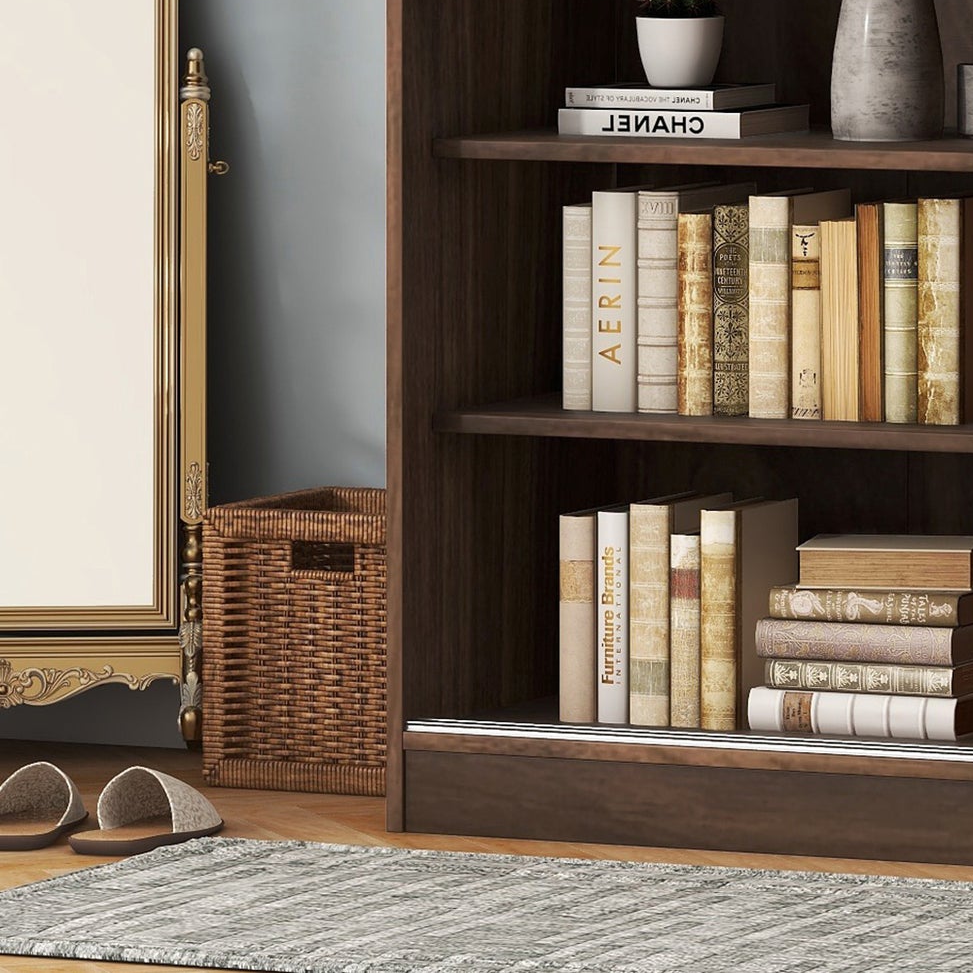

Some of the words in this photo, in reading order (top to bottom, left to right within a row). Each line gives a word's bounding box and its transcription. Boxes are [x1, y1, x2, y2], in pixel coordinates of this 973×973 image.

[598, 245, 621, 365] AERIN
[602, 546, 614, 605] Brands
[916, 594, 929, 623] TALES
[602, 610, 614, 685] Furniture
